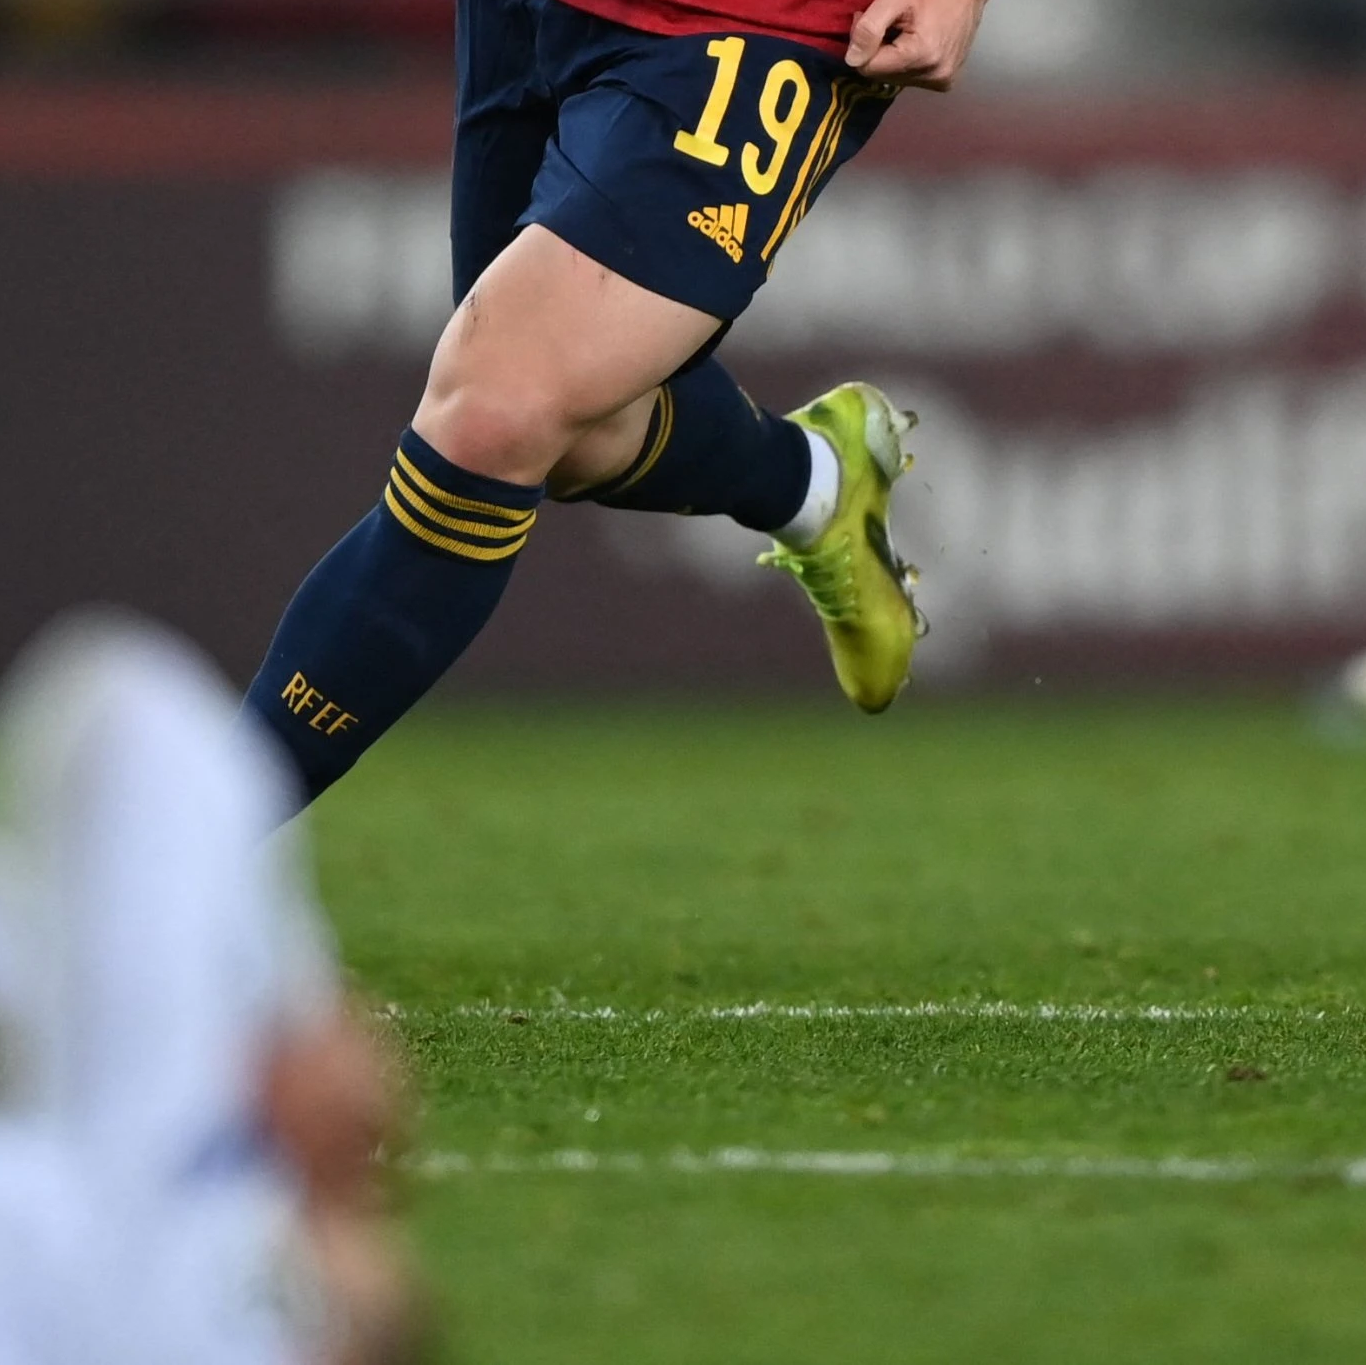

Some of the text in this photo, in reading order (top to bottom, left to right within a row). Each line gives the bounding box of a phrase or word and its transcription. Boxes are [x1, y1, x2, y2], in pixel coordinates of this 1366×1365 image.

[674, 37, 810, 195] 19
[687, 211, 743, 263] adidas
[281, 671, 359, 735] RFEF
